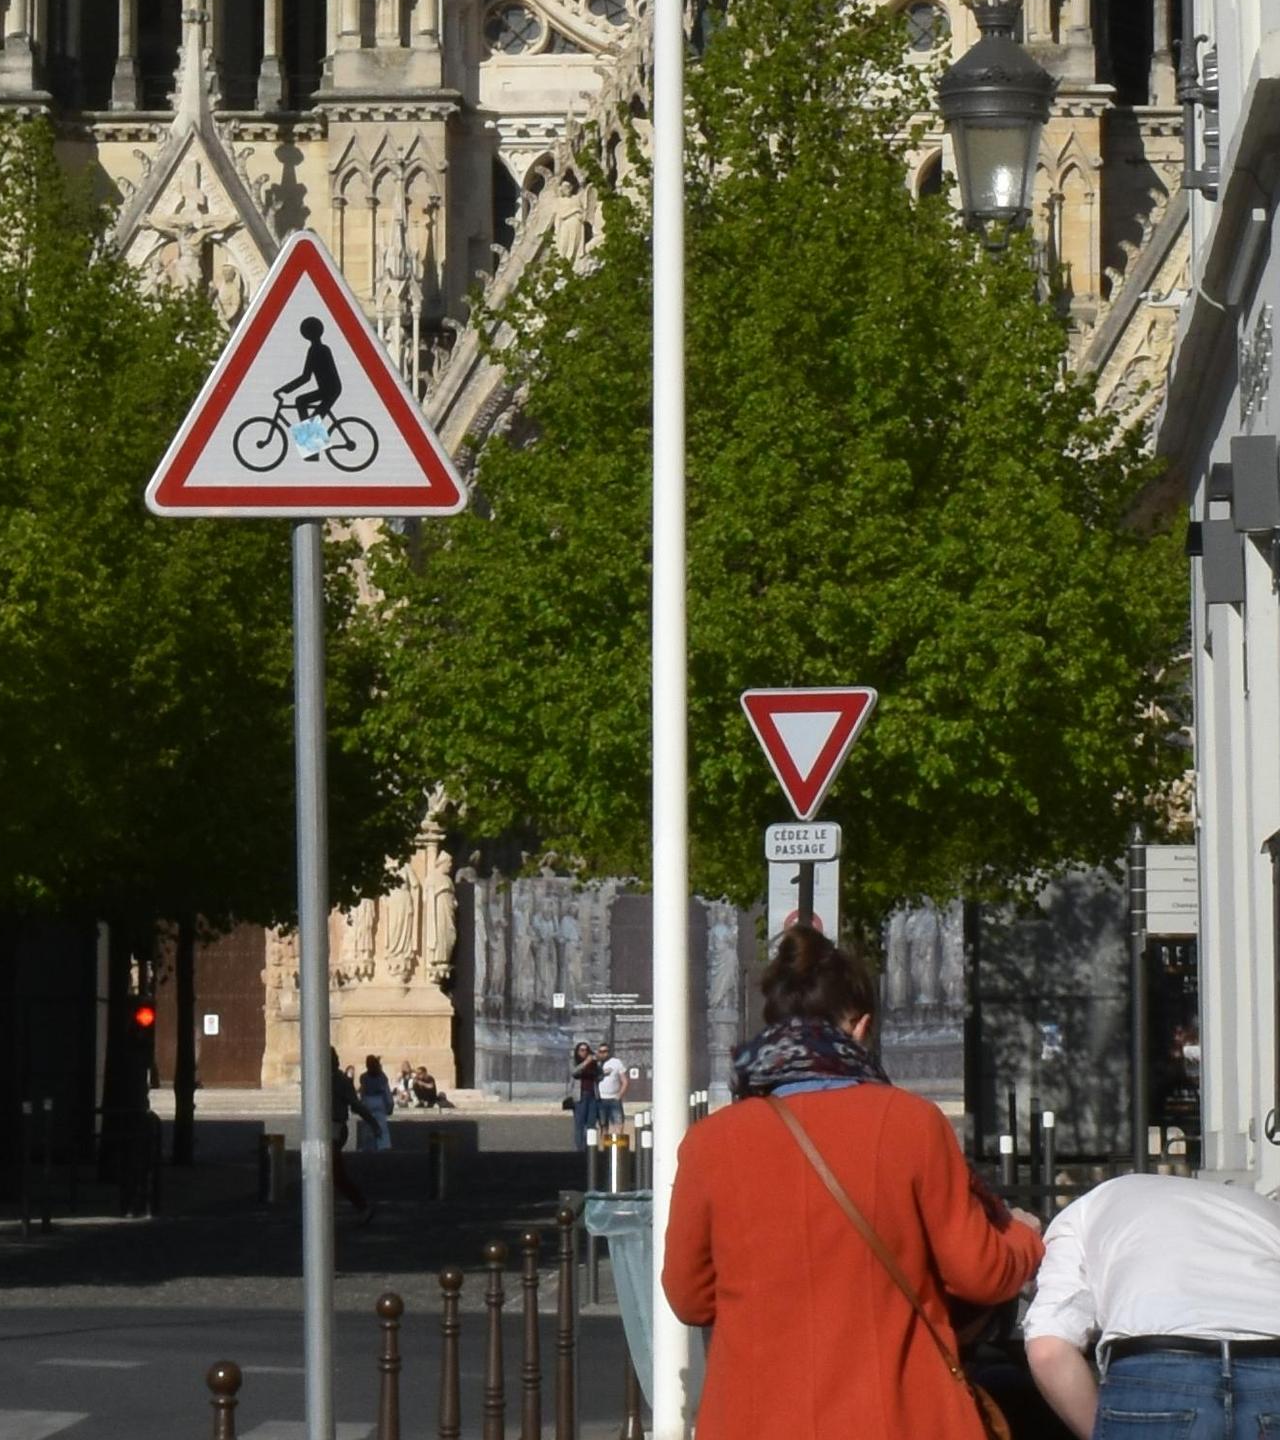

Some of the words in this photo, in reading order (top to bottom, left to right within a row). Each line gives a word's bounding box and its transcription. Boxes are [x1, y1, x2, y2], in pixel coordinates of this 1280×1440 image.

[773, 828, 809, 841] CÉDEZ
[814, 829, 827, 840] LE
[774, 843, 826, 855] PASSAGE
